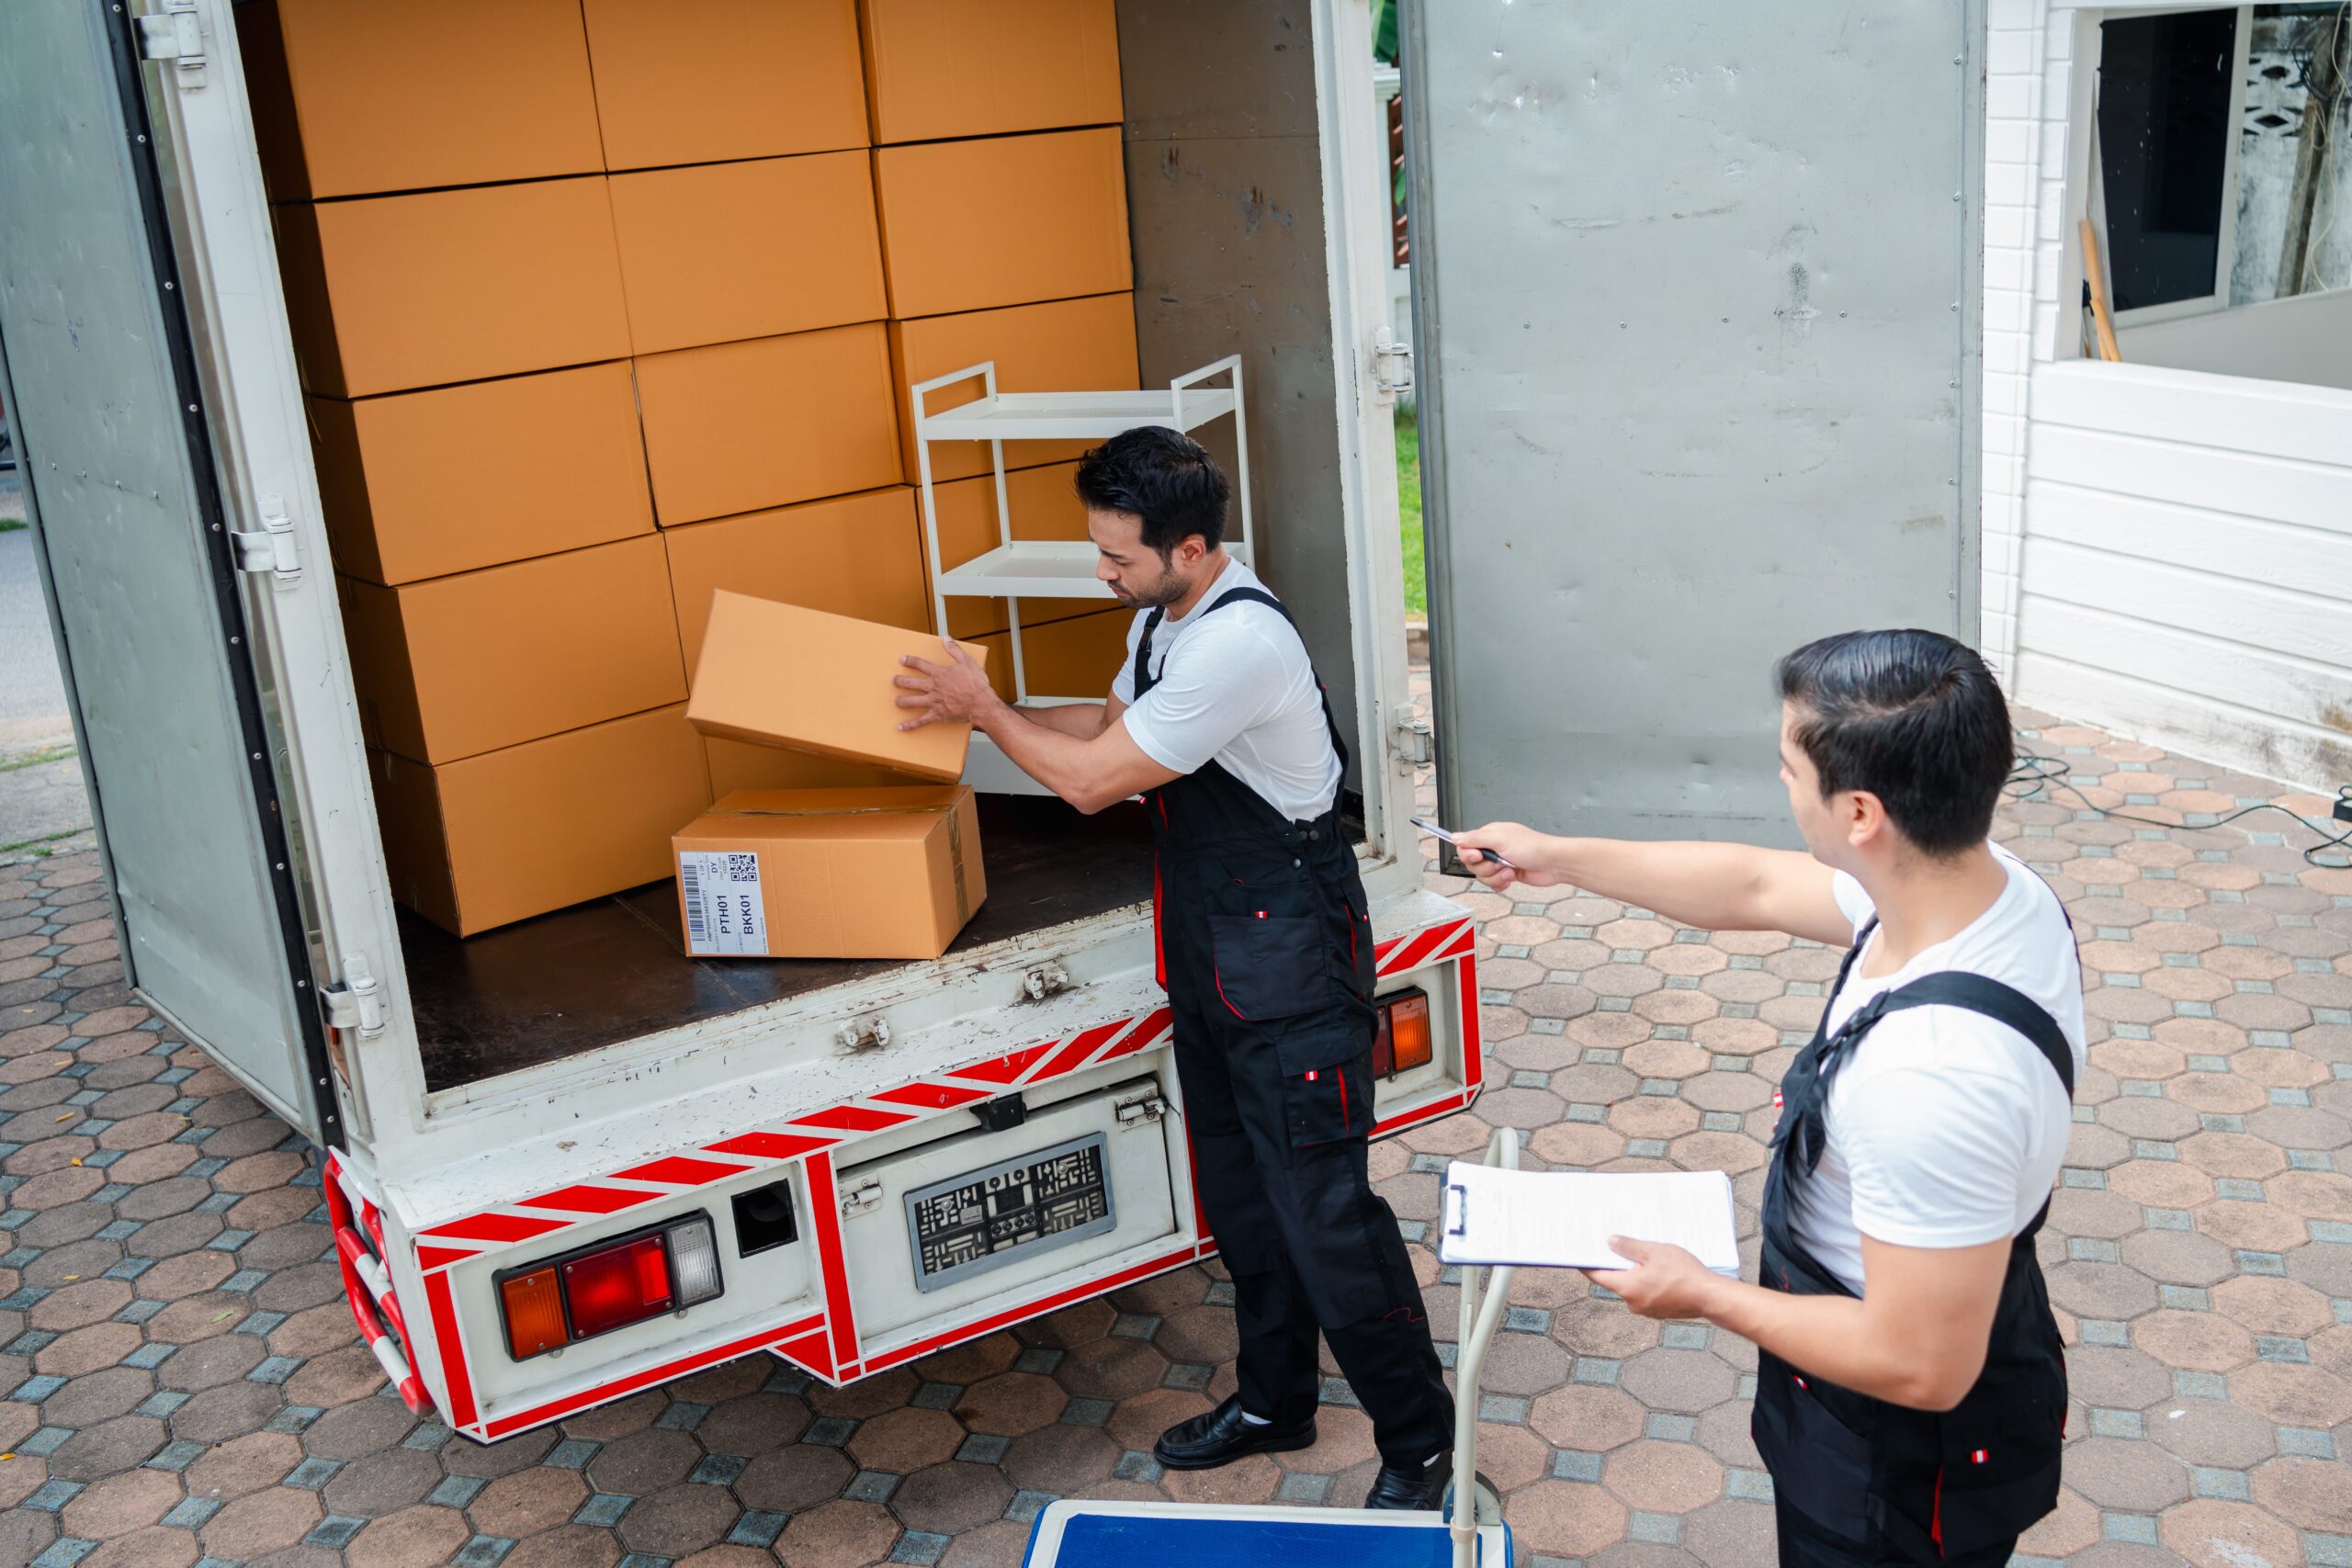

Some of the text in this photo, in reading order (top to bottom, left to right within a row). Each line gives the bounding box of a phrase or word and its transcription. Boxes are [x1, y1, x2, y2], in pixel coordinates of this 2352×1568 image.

[710, 862, 718, 874] DY
[717, 896, 730, 933] PTH01
[740, 895, 754, 934] BKK01
